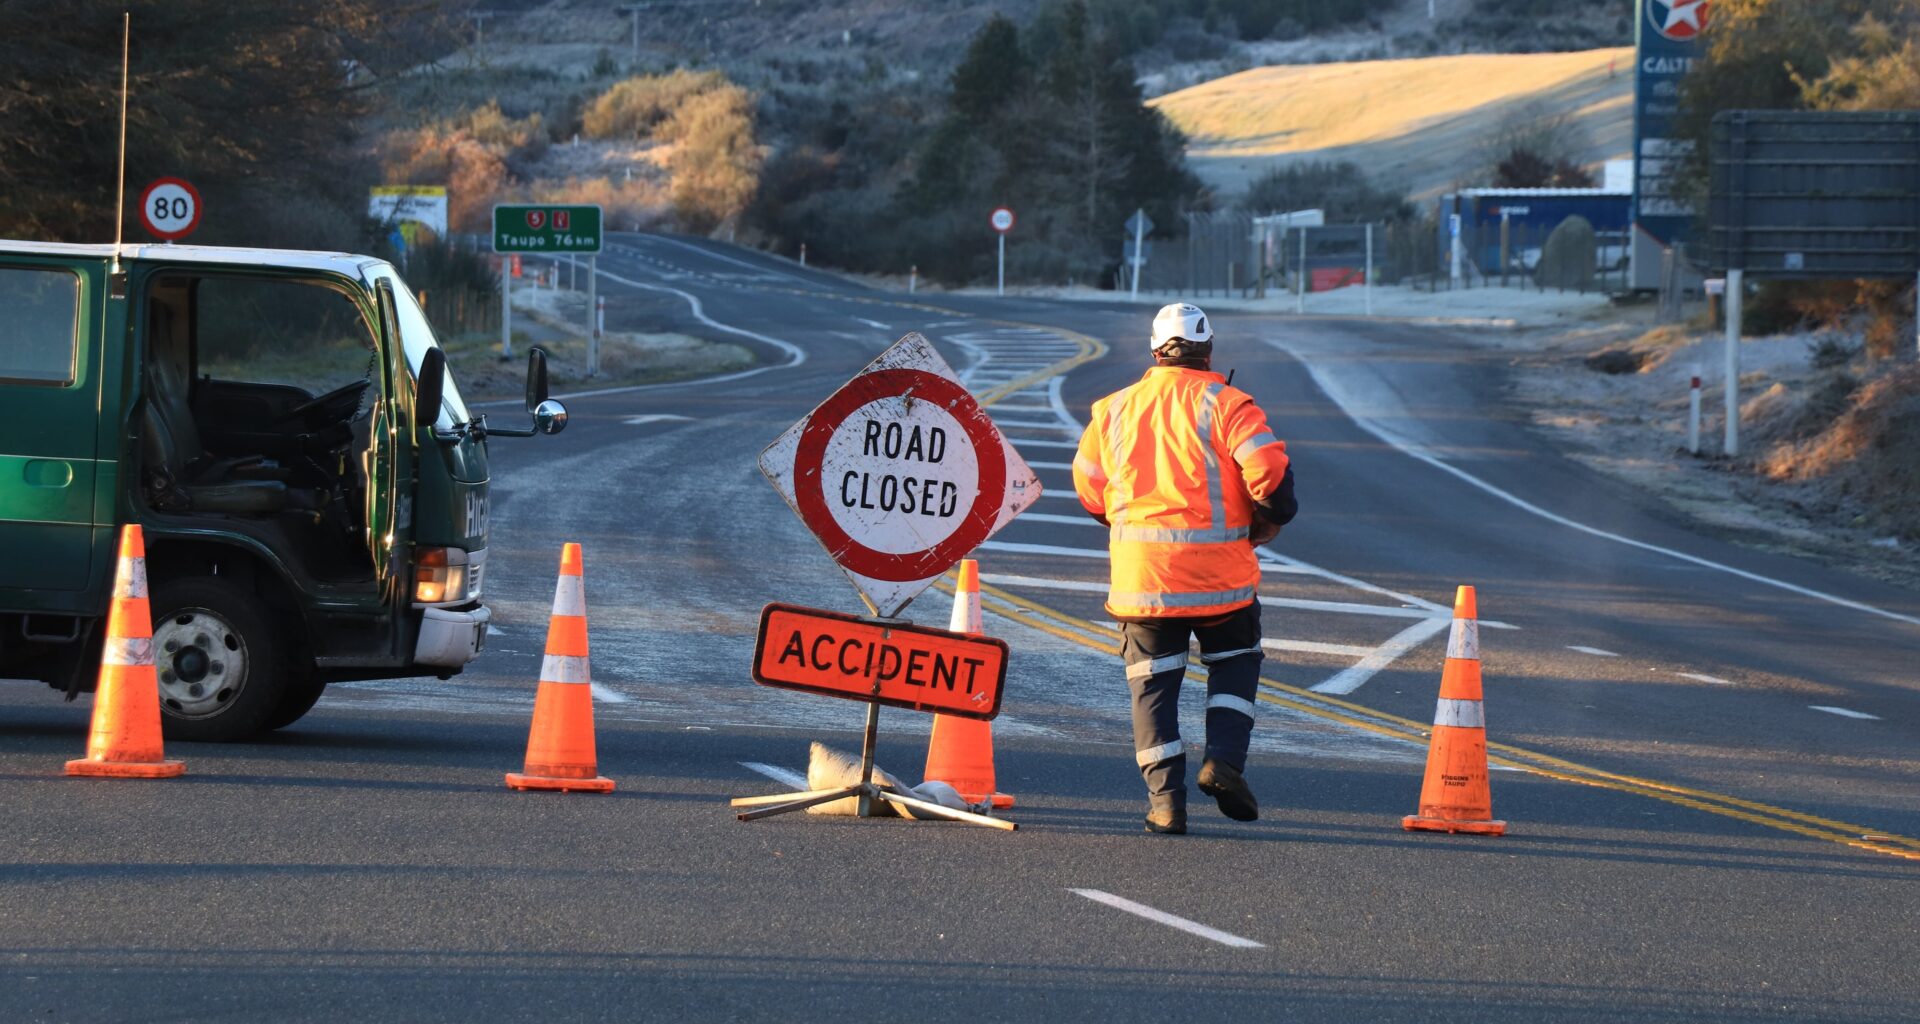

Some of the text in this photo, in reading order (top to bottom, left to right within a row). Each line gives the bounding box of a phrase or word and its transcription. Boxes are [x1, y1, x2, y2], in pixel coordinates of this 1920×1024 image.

[154, 197, 187, 219] 80
[532, 212, 541, 225] 5
[502, 234, 594, 248] Taupo 76 km
[863, 420, 946, 463] ROAD
[841, 470, 957, 517] CLOSED
[778, 630, 984, 694] ACCIDENT
